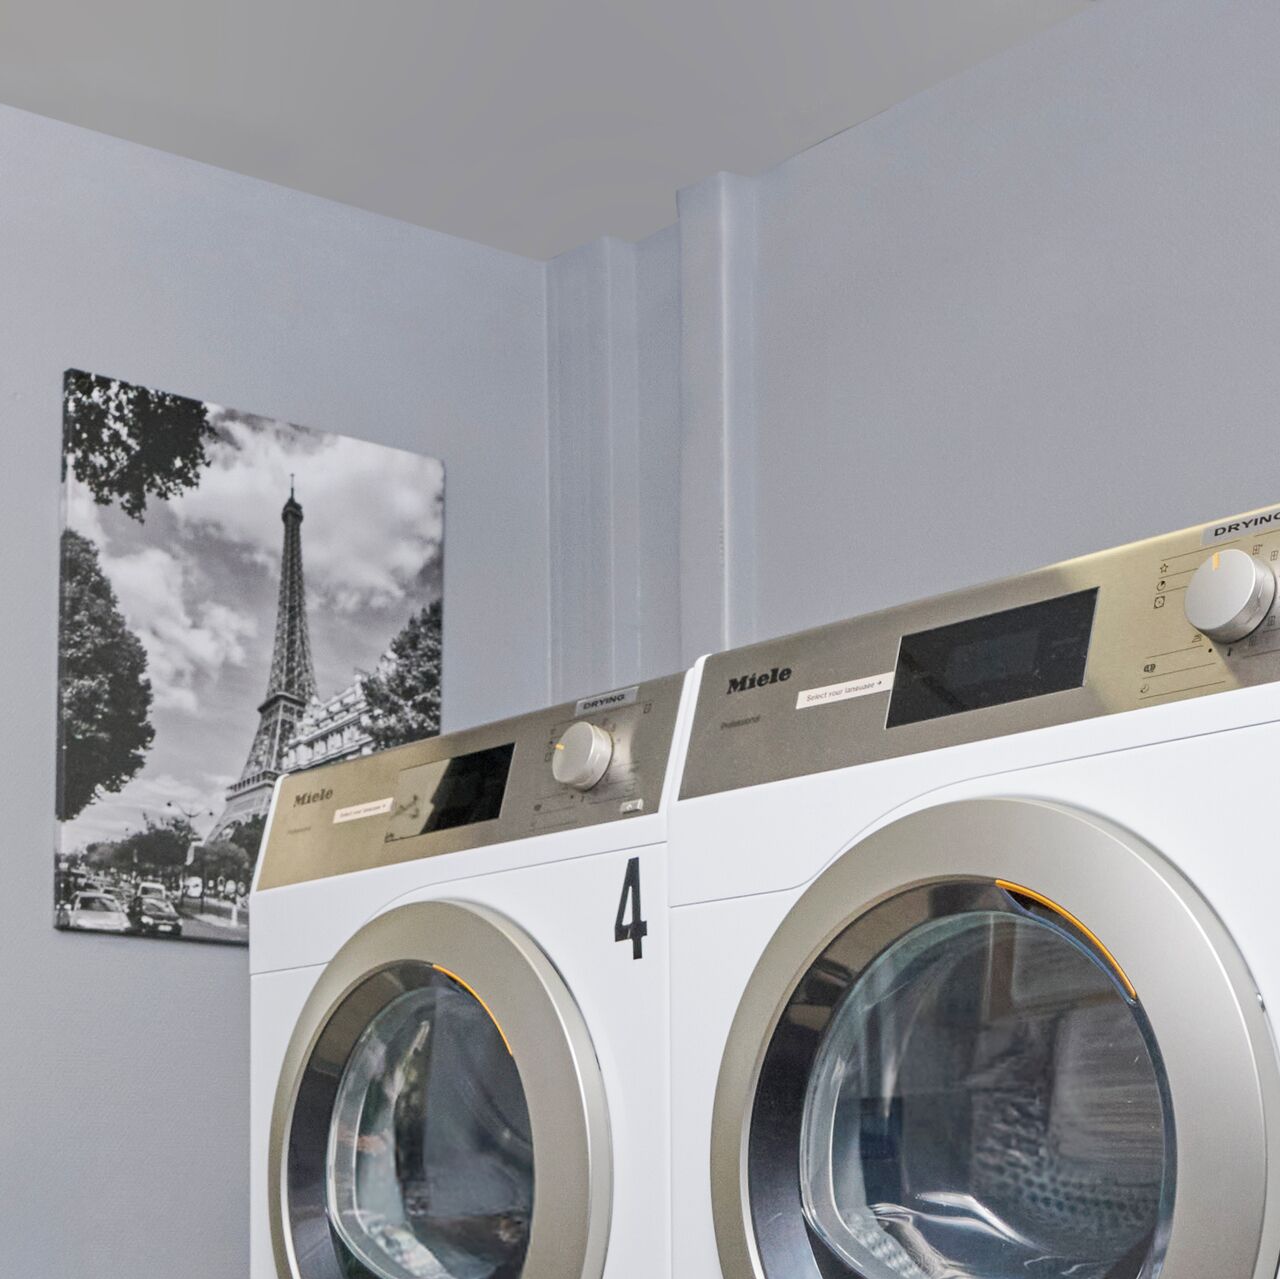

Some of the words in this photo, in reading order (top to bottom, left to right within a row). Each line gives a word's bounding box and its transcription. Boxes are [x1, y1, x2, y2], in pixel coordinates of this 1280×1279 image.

[726, 667, 792, 695] Miele
[583, 693, 625, 710] DRYING
[293, 788, 333, 808] Miele
[614, 857, 647, 960] 4
